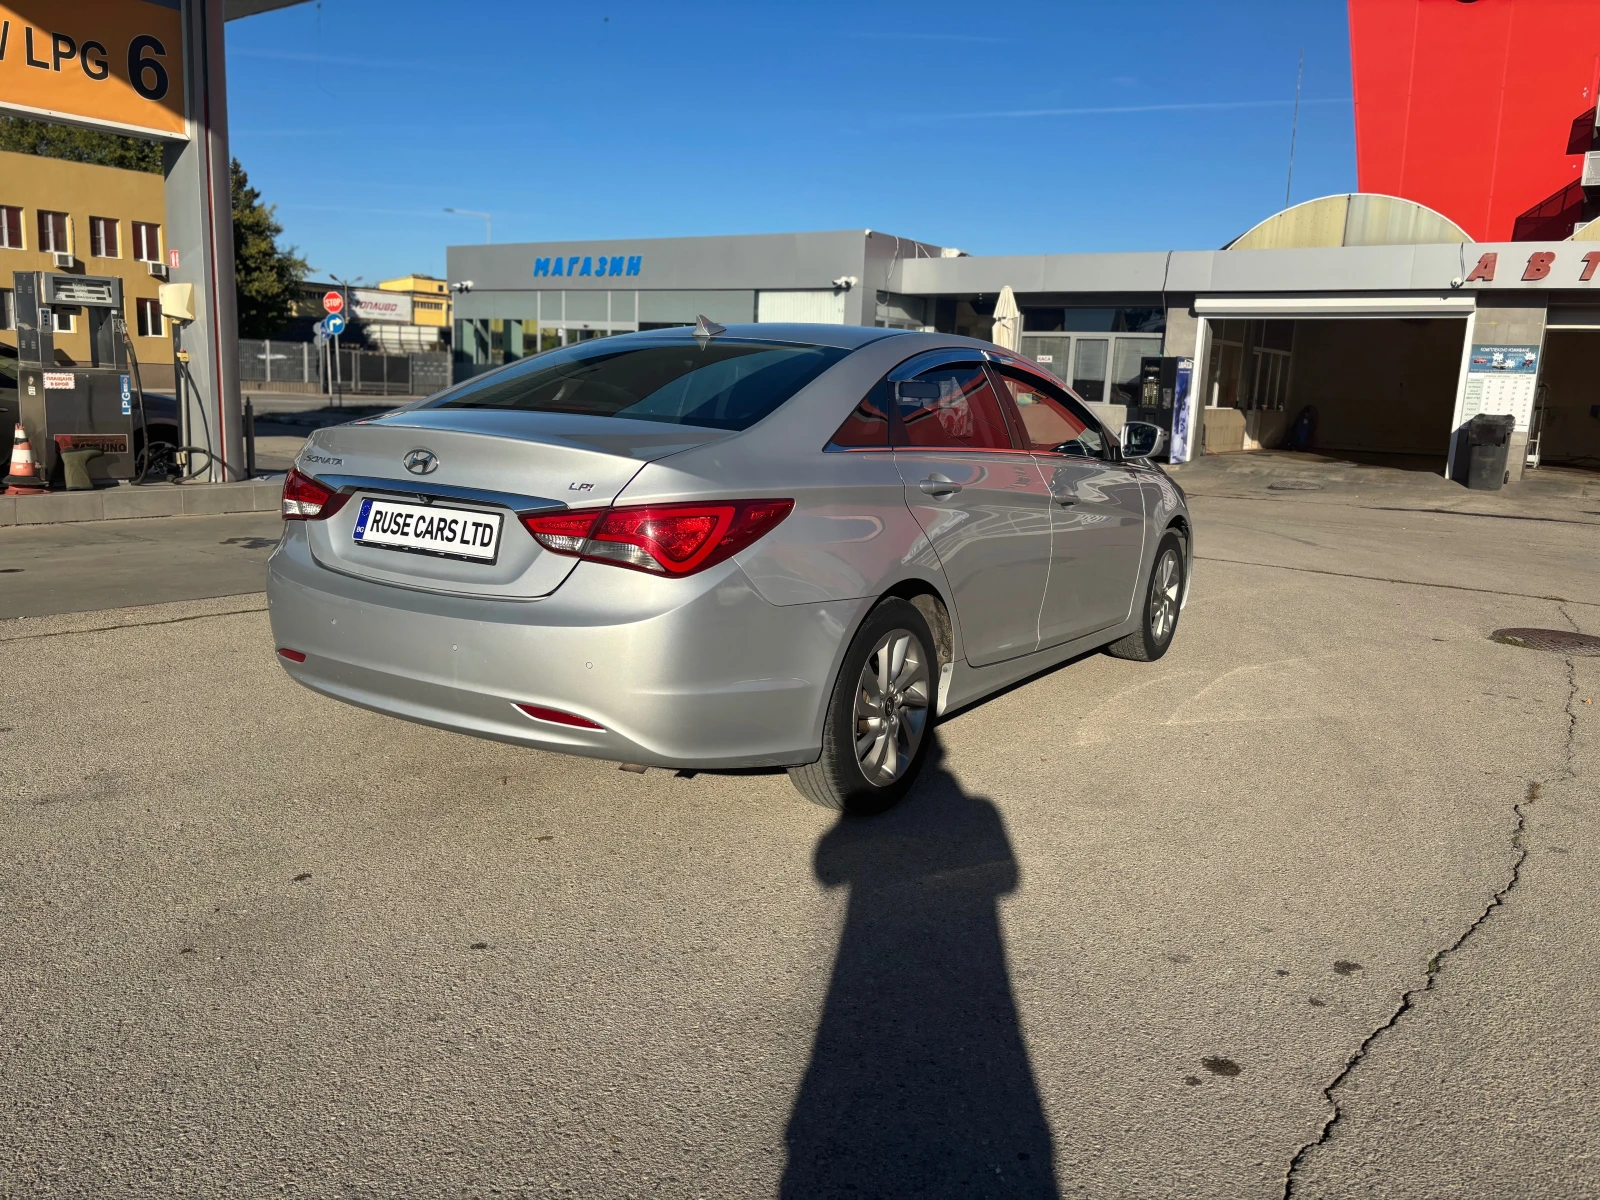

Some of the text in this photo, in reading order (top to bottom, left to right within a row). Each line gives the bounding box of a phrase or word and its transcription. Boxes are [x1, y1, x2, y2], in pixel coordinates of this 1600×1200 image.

[25, 26, 109, 81] LPG
[127, 34, 169, 101] 6
[533, 255, 643, 277] МАГАЗИН
[325, 298, 341, 306] STOP
[122, 392, 131, 415] LPG
[304, 454, 343, 466] SONATA
[370, 510, 494, 547] RUSE CARS LTD
